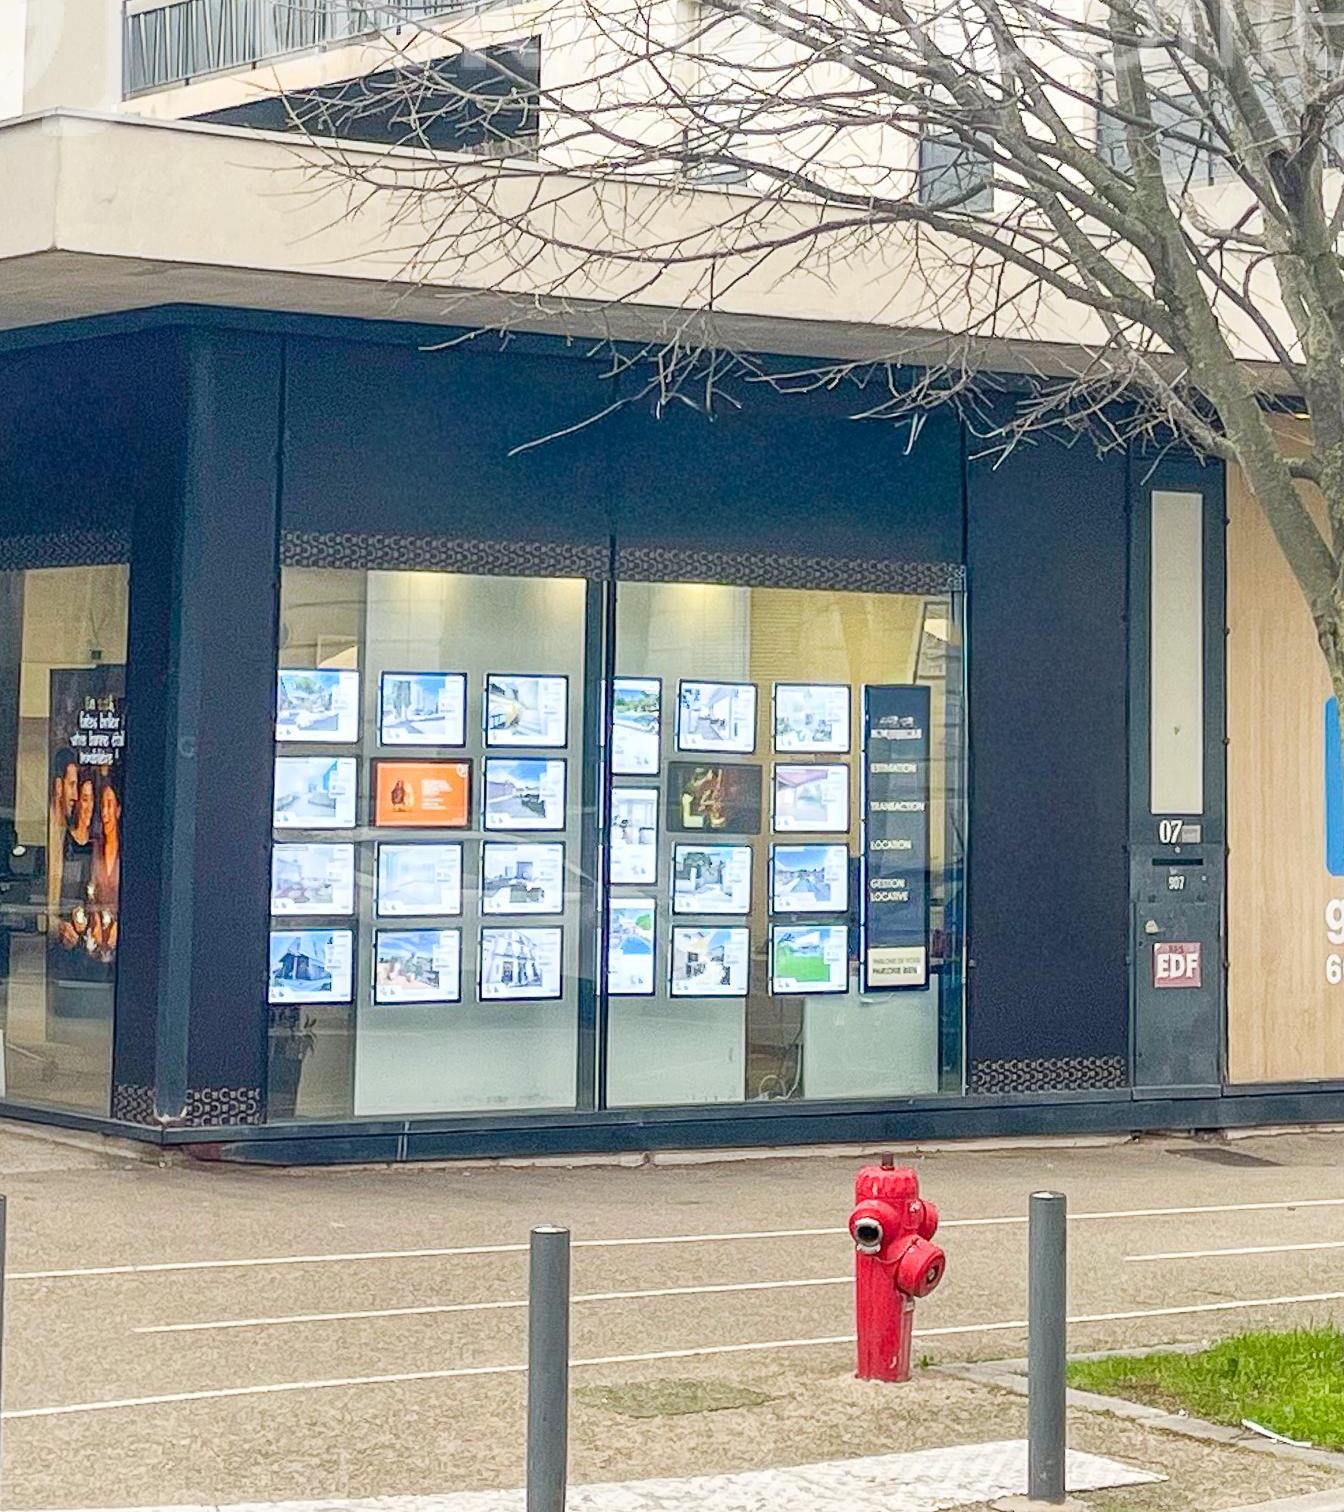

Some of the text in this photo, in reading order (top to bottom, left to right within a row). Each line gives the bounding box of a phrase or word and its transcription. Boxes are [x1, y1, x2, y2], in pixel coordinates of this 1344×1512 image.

[1158, 819, 1183, 844] 07
[870, 840, 912, 850] LOCATION
[1156, 952, 1199, 979] EDF
